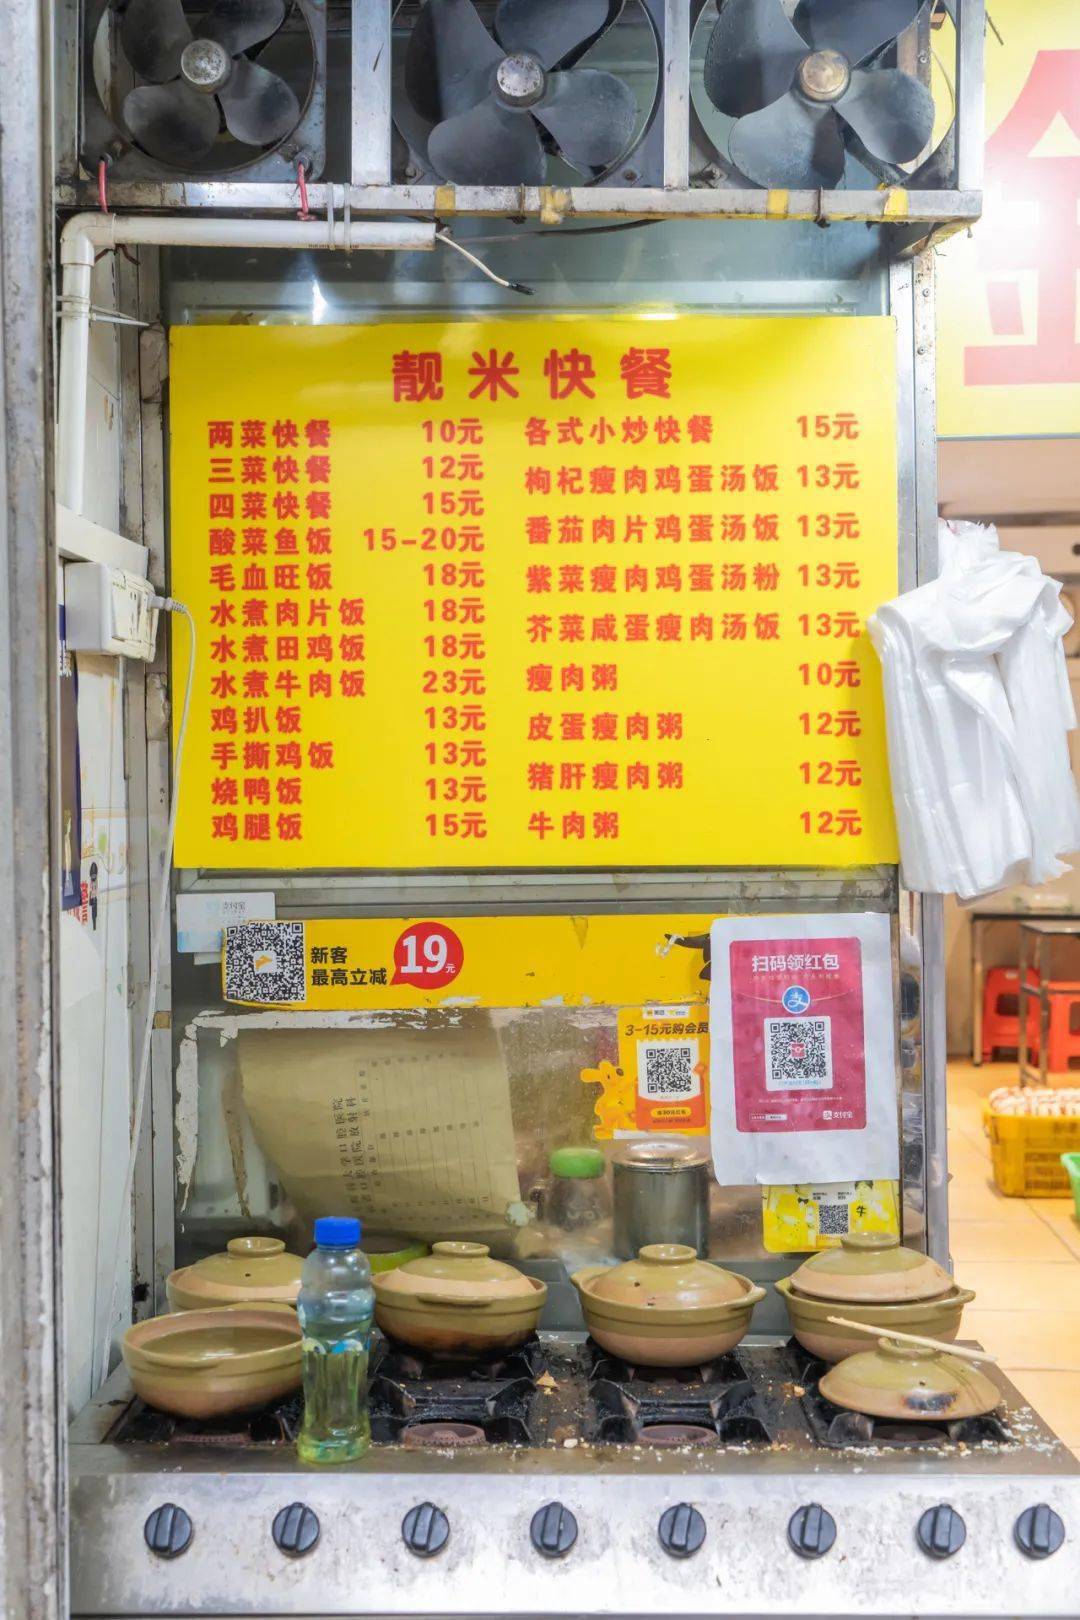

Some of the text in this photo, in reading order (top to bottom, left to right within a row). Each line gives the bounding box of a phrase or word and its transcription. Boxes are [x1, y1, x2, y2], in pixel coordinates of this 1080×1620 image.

[391, 347, 672, 403] 靓米快餐
[208, 417, 484, 449] 两菜快餐 10元
[525, 413, 860, 446] 各式小炒快餐 15元
[208, 453, 484, 485] 三菜快餐 12元
[525, 462, 860, 495] 枸杞瘦肉鸡蛋汤饭 13元
[209, 489, 485, 521] 四菜快餐 15元
[209, 525, 485, 556] 酸菜鱼饭 15-20元
[526, 512, 860, 544] 番茄肉片鸡蛋汤饭 13元
[209, 562, 485, 592] 毛血旺饭 18元
[526, 562, 860, 594] 紫菜瘦肉鸡蛋汤粉 13元
[210, 597, 485, 628] 水煮肉片饭 18元
[527, 611, 861, 643] 芥菜咸蛋瘦肉汤饭 13元
[210, 633, 486, 664] 水煮田鸡饭 18元
[210, 669, 486, 699] 水煮牛肉饭 23元
[527, 660, 862, 692] 瘦肉粥 10元
[211, 704, 486, 735] 鸡扒饭 13元
[527, 710, 862, 741] 皮蛋瘦肉粥 12元
[211, 740, 487, 770] 手撕鸡饭 13元
[528, 759, 862, 791] 猪肝瘦肉粥 12元
[211, 776, 487, 806] 烧鸭饭 13元
[211, 812, 487, 842] 鸡腿饭 15元
[528, 809, 862, 840] 牛肉粥 12元
[311, 946, 348, 965] 新客
[752, 952, 840, 973] 扫码领红包
[311, 967, 387, 987] 最高立减
[625, 1021, 709, 1037] 3-15元购会员
